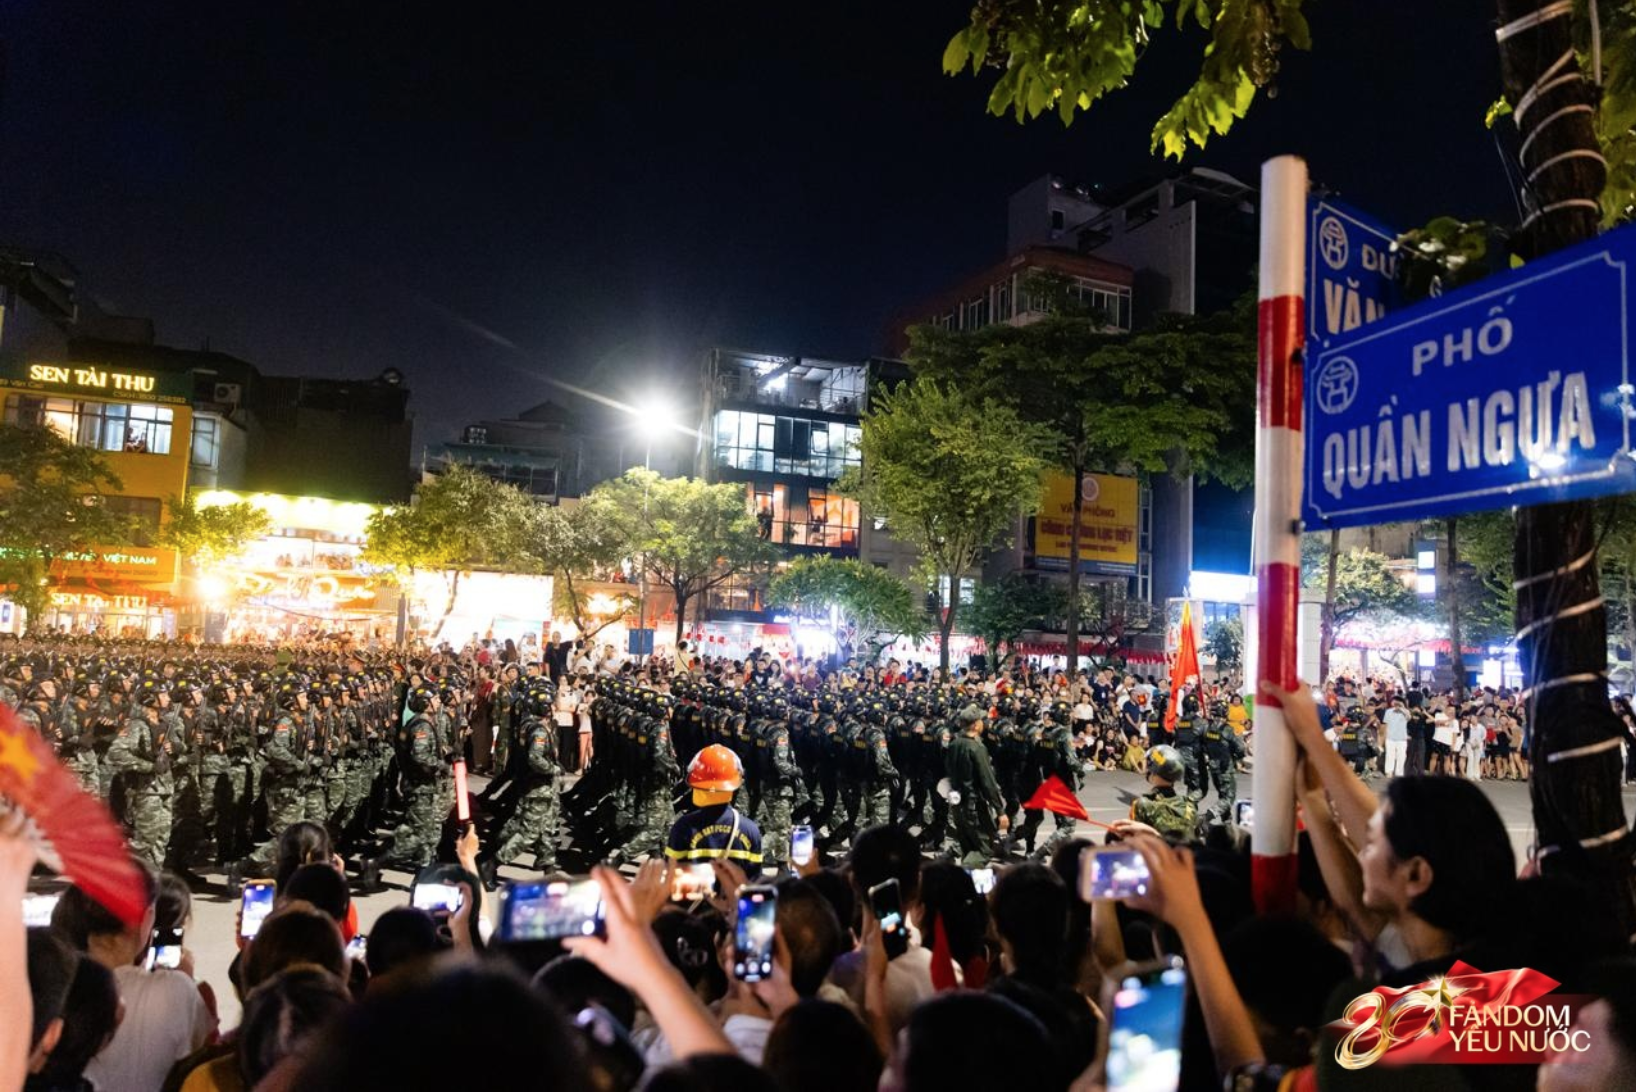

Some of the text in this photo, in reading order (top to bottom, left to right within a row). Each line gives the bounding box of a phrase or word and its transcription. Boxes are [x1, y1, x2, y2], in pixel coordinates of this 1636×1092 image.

[1412, 295, 1515, 376] PHỐ
[30, 364, 69, 384] SEN
[74, 366, 107, 388] TÀI
[111, 373, 155, 392] THU
[1323, 370, 1596, 499] QUẦN NGỰA
[103, 553, 128, 564] VIỆT
[130, 555, 157, 565] NAM
[50, 593, 82, 606] SEN
